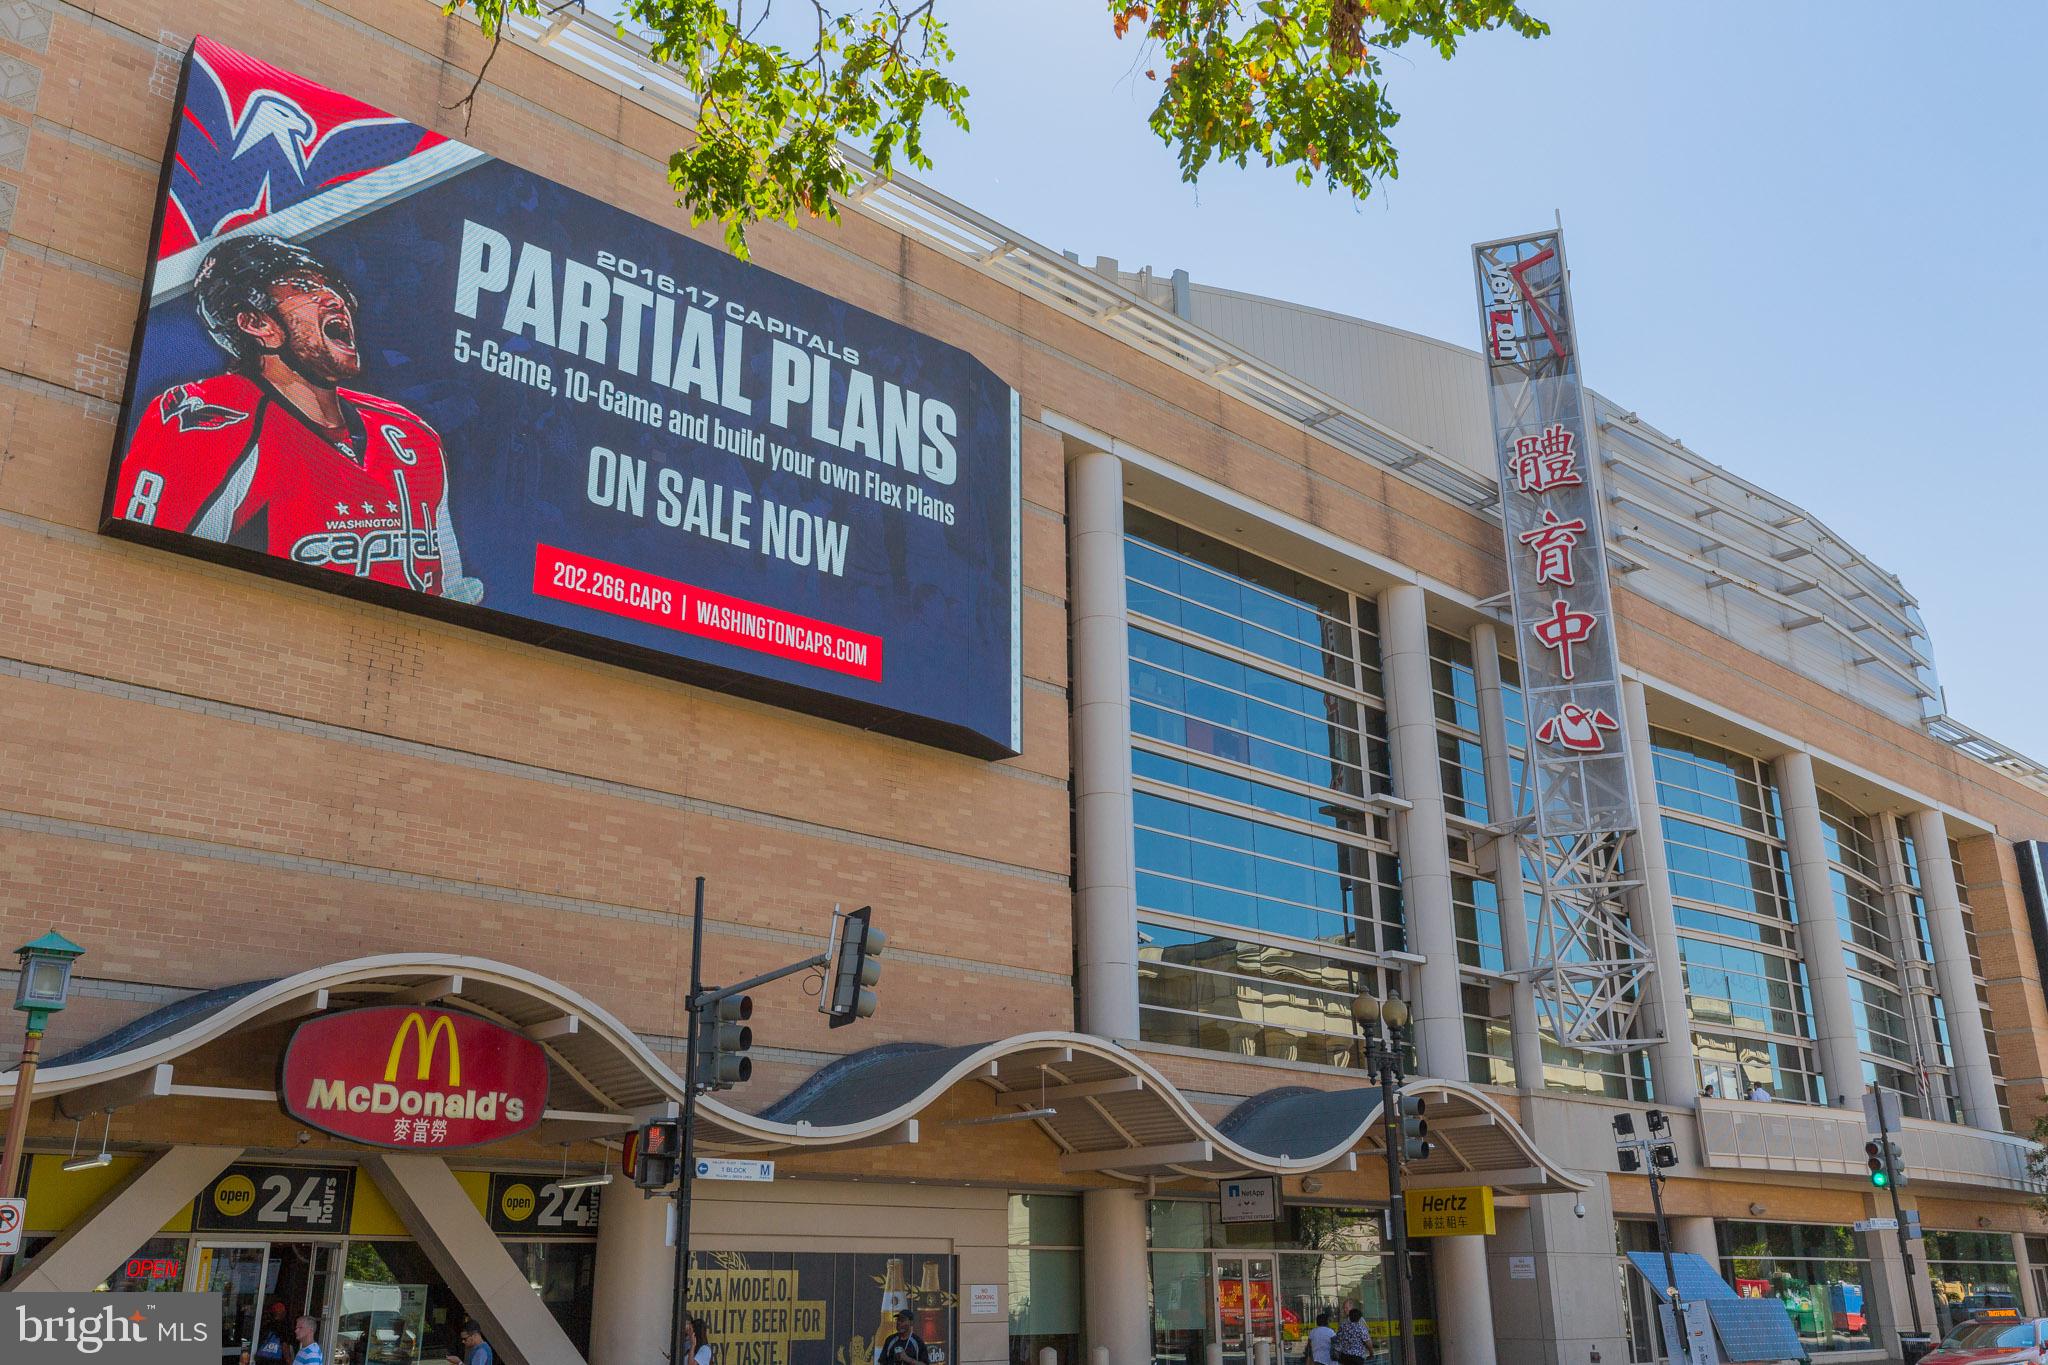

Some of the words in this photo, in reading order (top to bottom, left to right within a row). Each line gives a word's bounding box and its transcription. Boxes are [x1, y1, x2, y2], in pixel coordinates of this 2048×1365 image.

[597, 250, 719, 309] 2016-17
[726, 301, 860, 366] CAPITALS
[454, 218, 752, 416] PARTIAL
[769, 338, 958, 486] PLANS
[380, 424, 417, 466] C
[454, 329, 558, 398] 5-Game,
[565, 367, 663, 429] 10-Game
[669, 406, 709, 446] and
[714, 424, 766, 464] build
[770, 441, 815, 476] your
[820, 461, 860, 496] own
[864, 470, 903, 509] Flex
[906, 485, 956, 526] Plans
[126, 470, 165, 525] 8
[587, 445, 647, 519] ON
[656, 467, 753, 550] SALE
[761, 499, 850, 577] NOW
[326, 517, 401, 531] WASHINGTON
[1509, 424, 1620, 751] 體育中心
[553, 561, 672, 615] 202.266.CAPS
[696, 600, 868, 667] WASHINGTONCAPS.COM
[306, 1078, 525, 1122] McDonald's
[393, 1118, 447, 1144] 麥當勞
[220, 1189, 250, 1205] open
[257, 1174, 322, 1224] 24
[318, 1177, 337, 1224] hours
[507, 1196, 531, 1211] open
[537, 1184, 590, 1226] 24
[1422, 1195, 1467, 1212] Hertz
[126, 1259, 180, 1279] OPEN
[686, 1277, 722, 1302] CASA
[729, 1277, 791, 1302] MODELO.
[752, 1308, 787, 1333] BEER
[794, 1308, 821, 1332] FOR
[735, 1341, 783, 1365] TASTE.
